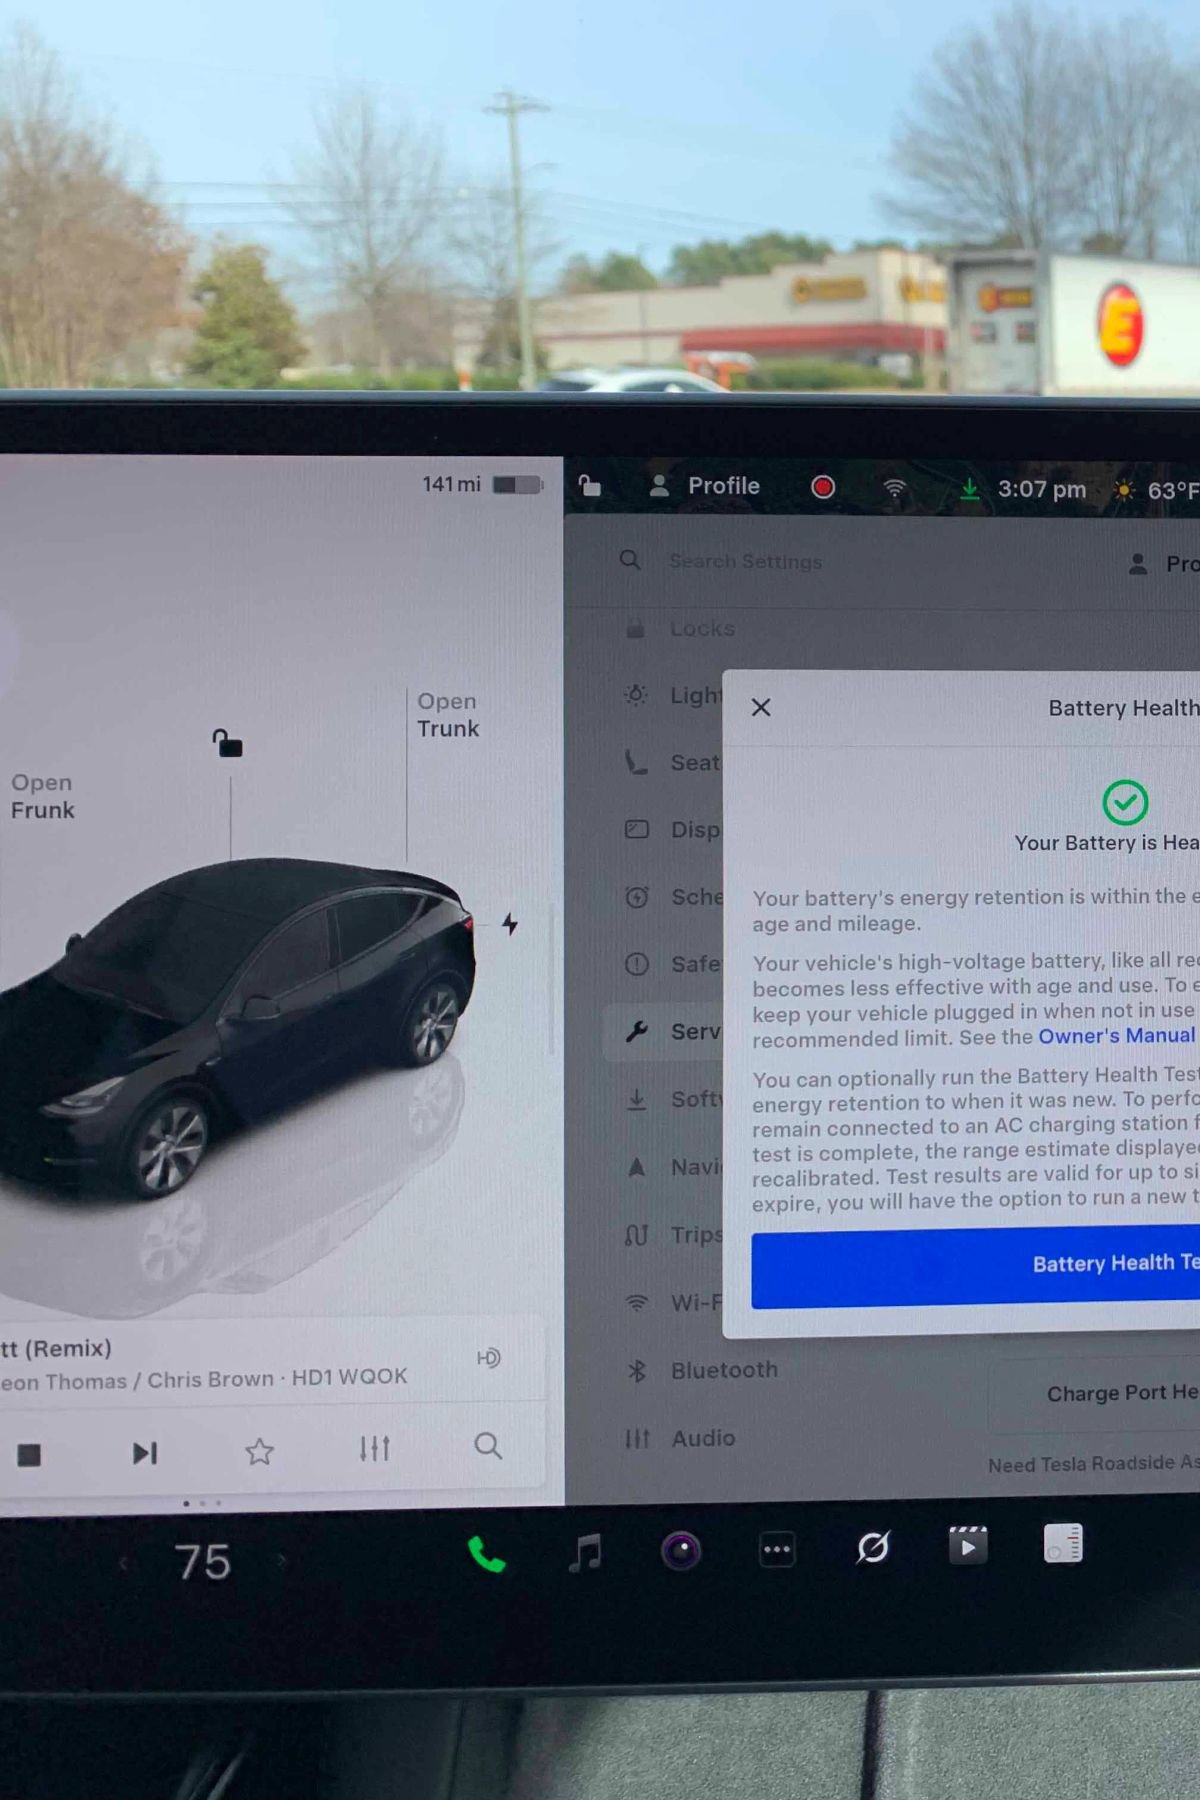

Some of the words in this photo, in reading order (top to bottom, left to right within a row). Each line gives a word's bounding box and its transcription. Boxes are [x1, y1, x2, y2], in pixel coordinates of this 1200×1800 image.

[1100, 297, 1141, 355] E
[422, 475, 452, 492] 141
[457, 474, 480, 492] mi
[689, 475, 760, 495] Profile
[998, 479, 1047, 498] 3:07
[1053, 483, 1086, 503] pm
[1148, 480, 1200, 500] 63°F
[668, 551, 736, 569] Search
[742, 552, 822, 573] Settings
[670, 618, 735, 637] Locks
[417, 691, 476, 713] Open
[1049, 699, 1126, 721] Battery
[1133, 698, 1200, 716] Health
[416, 718, 479, 737] Trunk
[671, 754, 721, 772] Seat
[10, 773, 72, 795] Open
[11, 800, 75, 819] Frunk
[671, 821, 721, 843] Disp
[1014, 834, 1059, 851] Your
[1065, 834, 1136, 854] Battery
[1141, 833, 1157, 850] is
[752, 889, 799, 907] Your
[804, 888, 894, 910] battery's
[899, 892, 969, 909] energy
[974, 887, 1063, 905] retention
[1069, 887, 1085, 904] is
[1090, 886, 1150, 904] within
[1154, 886, 1186, 904] the
[752, 919, 789, 936] age
[794, 914, 831, 932] and
[837, 913, 921, 935] mileage.
[671, 955, 722, 974] Safe
[752, 955, 799, 972] Your
[804, 953, 892, 971] vehicle's
[898, 951, 1025, 974] high-voltage
[1031, 951, 1105, 972] battery,
[1111, 950, 1144, 968] like
[1149, 950, 1170, 968] all
[752, 979, 845, 997] becomes
[850, 978, 889, 996] less
[895, 977, 983, 995] effective
[988, 976, 1031, 994] with
[1036, 980, 1072, 997] age
[1077, 975, 1113, 993] and
[1118, 979, 1158, 993] use.
[1164, 976, 1187, 993] To
[752, 1005, 800, 1026] keep
[806, 1008, 851, 1026] your
[856, 1003, 928, 1022] vehicle
[933, 1002, 1014, 1024] plugged
[1020, 1002, 1037, 1019] in
[1043, 1001, 1095, 1019] when
[1101, 1002, 1133, 1018] not
[1138, 1000, 1155, 1018] in
[1160, 1004, 1195, 1018] use
[671, 1023, 721, 1041] Serv
[753, 1029, 898, 1048] recommended
[904, 1028, 952, 1046] limit.
[959, 1029, 996, 1045] See
[1001, 1027, 1033, 1045] the
[1038, 1026, 1120, 1045] Owner's
[1125, 1024, 1195, 1043] Manual
[752, 1071, 790, 1088] You
[796, 1074, 831, 1088] can
[837, 1067, 936, 1091] optionally
[941, 1072, 974, 1085] run
[979, 1067, 1012, 1085] the
[1017, 1067, 1089, 1086] Battery
[1095, 1064, 1158, 1083] Health
[671, 1090, 723, 1108] Soft
[671, 1157, 722, 1176] Navi
[751, 1193, 821, 1216] expire,
[827, 1197, 863, 1215] you
[869, 1191, 902, 1210] will
[908, 1191, 955, 1209] have
[960, 1190, 993, 1208] the
[998, 1189, 1061, 1210] option
[1067, 1189, 1087, 1206] to
[1092, 1192, 1124, 1205] run
[1130, 1191, 1141, 1205] a
[1146, 1191, 1186, 1204] new
[1033, 1255, 1105, 1275] Battery
[1111, 1252, 1174, 1271] Health
[25, 1337, 111, 1361] (Remix)
[0, 1377, 39, 1391] eon
[45, 1372, 127, 1390] Thomas
[147, 1370, 202, 1389] Chris
[208, 1370, 274, 1388] Brown
[292, 1368, 331, 1386] HD1
[338, 1367, 407, 1385] WQOK
[671, 1359, 777, 1380] Bluetooth
[1047, 1385, 1119, 1405] Charge
[1125, 1383, 1167, 1400] Port
[671, 1428, 735, 1447] Audio
[988, 1456, 1035, 1473] Need
[1040, 1456, 1086, 1472] Tesla
[1091, 1454, 1175, 1471] Roadside
[174, 1543, 230, 1579] 75
